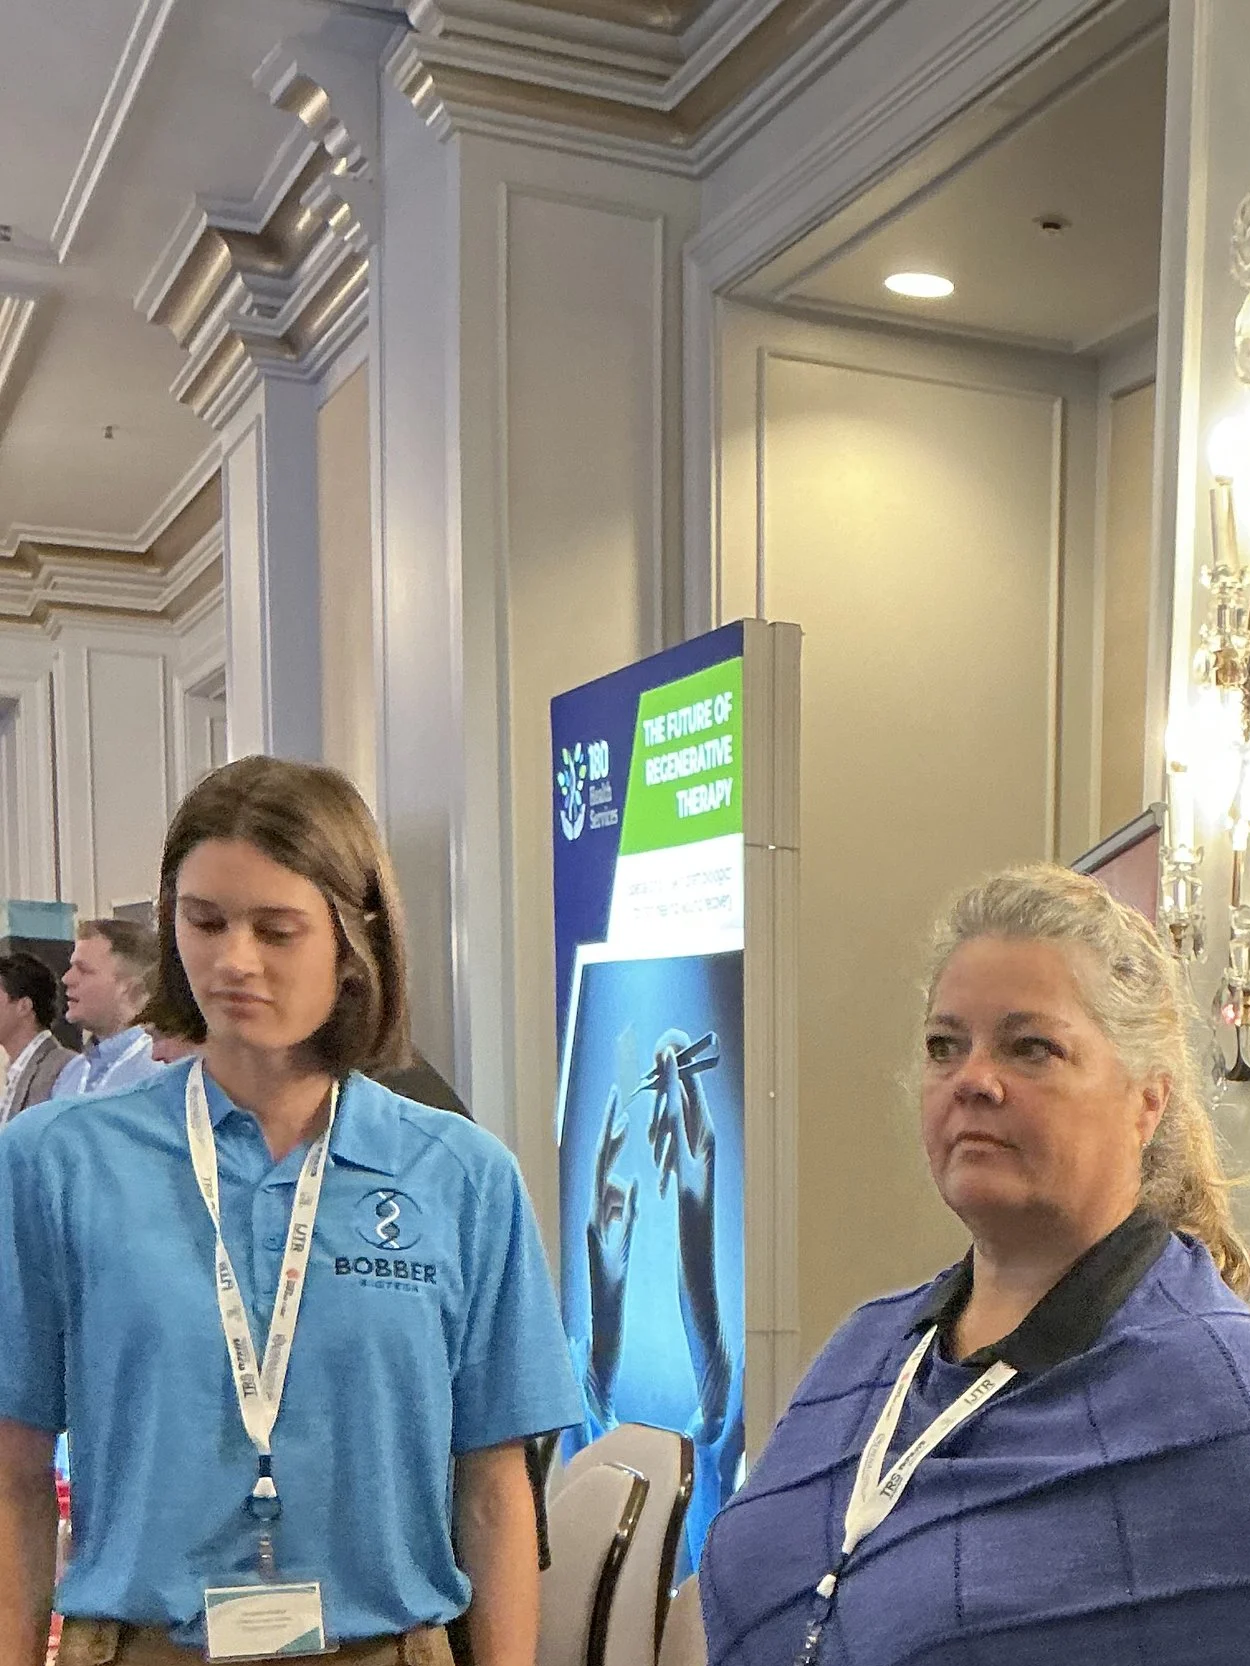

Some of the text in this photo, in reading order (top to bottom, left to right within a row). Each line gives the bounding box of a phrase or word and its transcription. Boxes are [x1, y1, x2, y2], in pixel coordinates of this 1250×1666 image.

[643, 691, 733, 747] THE FUTURE OF
[645, 735, 733, 787] REGENERATIVE
[676, 777, 733, 818] THERAPY
[335, 1256, 437, 1285] BOBBER
[964, 1379, 995, 1406] IJTR
[879, 1473, 901, 1499] TRS
